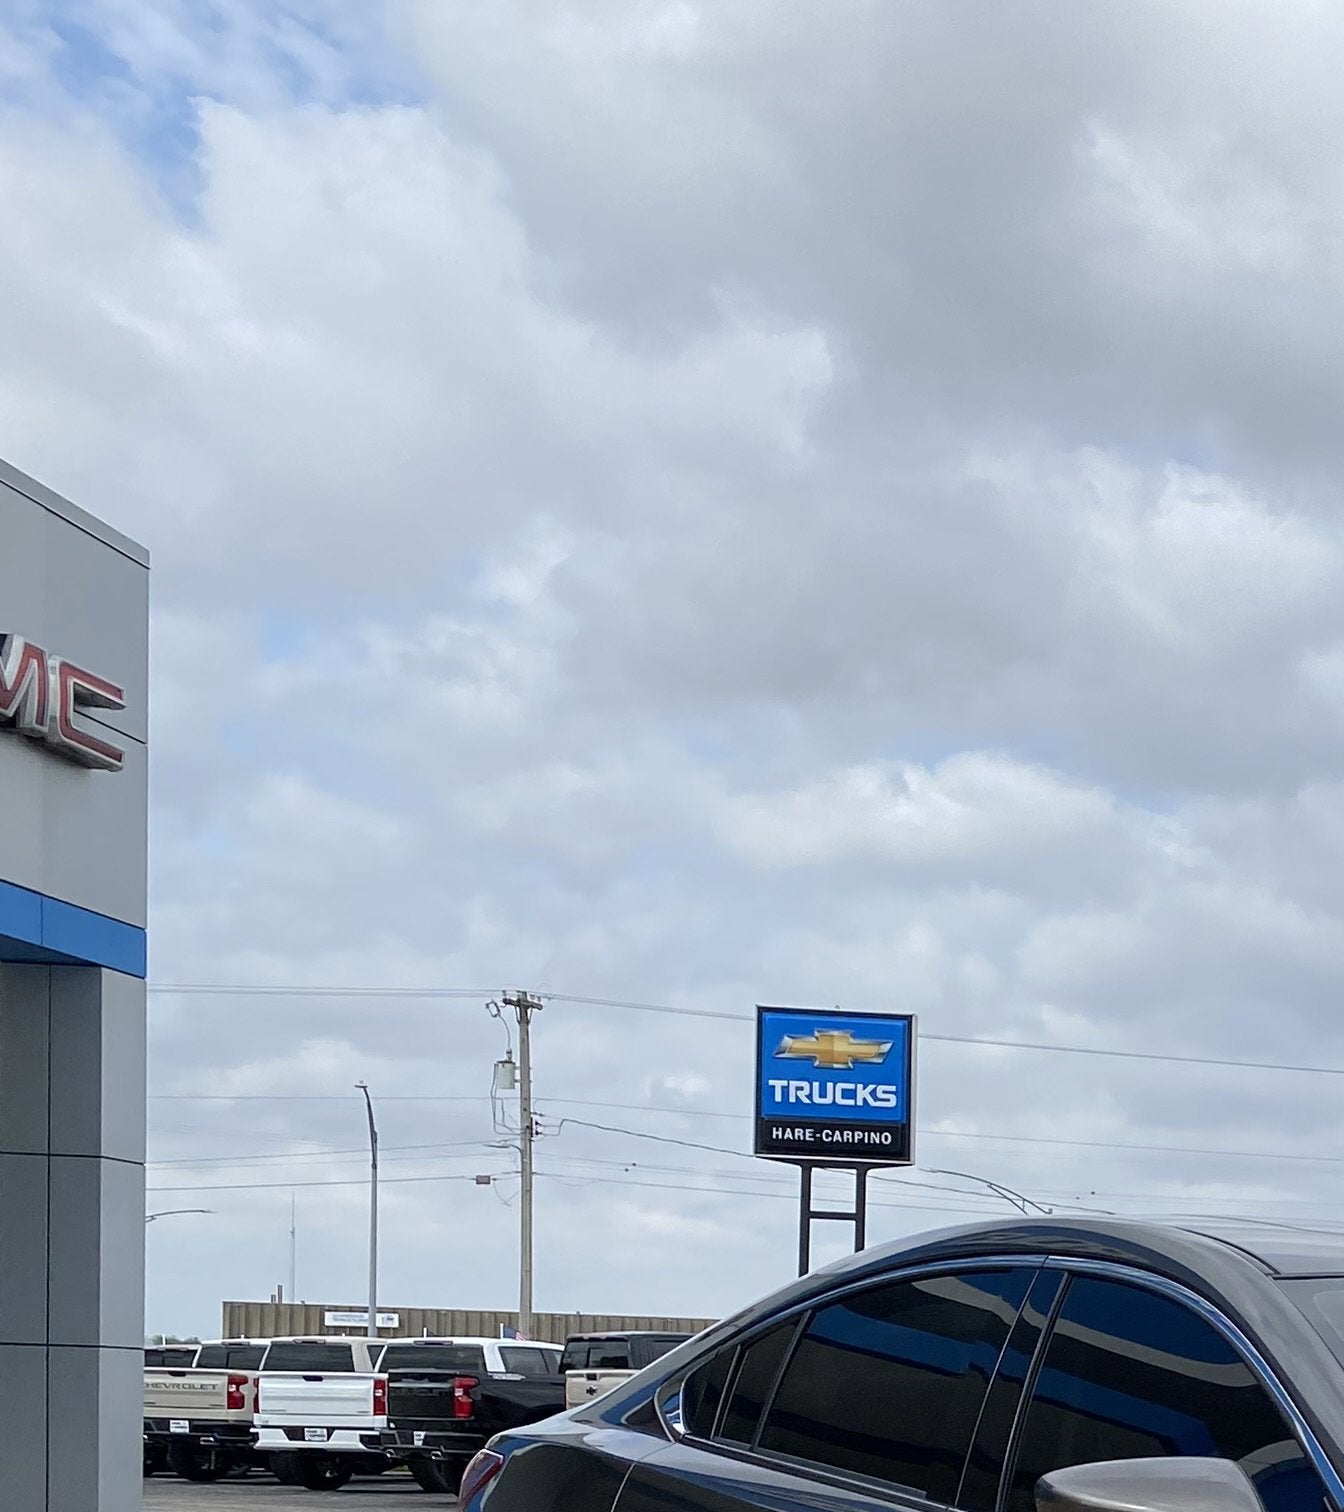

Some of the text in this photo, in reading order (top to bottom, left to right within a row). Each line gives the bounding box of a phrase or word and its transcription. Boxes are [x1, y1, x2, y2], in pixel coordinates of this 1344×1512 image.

[768, 1079, 897, 1108] TRUCKS
[772, 1127, 893, 1145] HARE-CARPINO
[146, 1382, 219, 1391] HEVROLET
